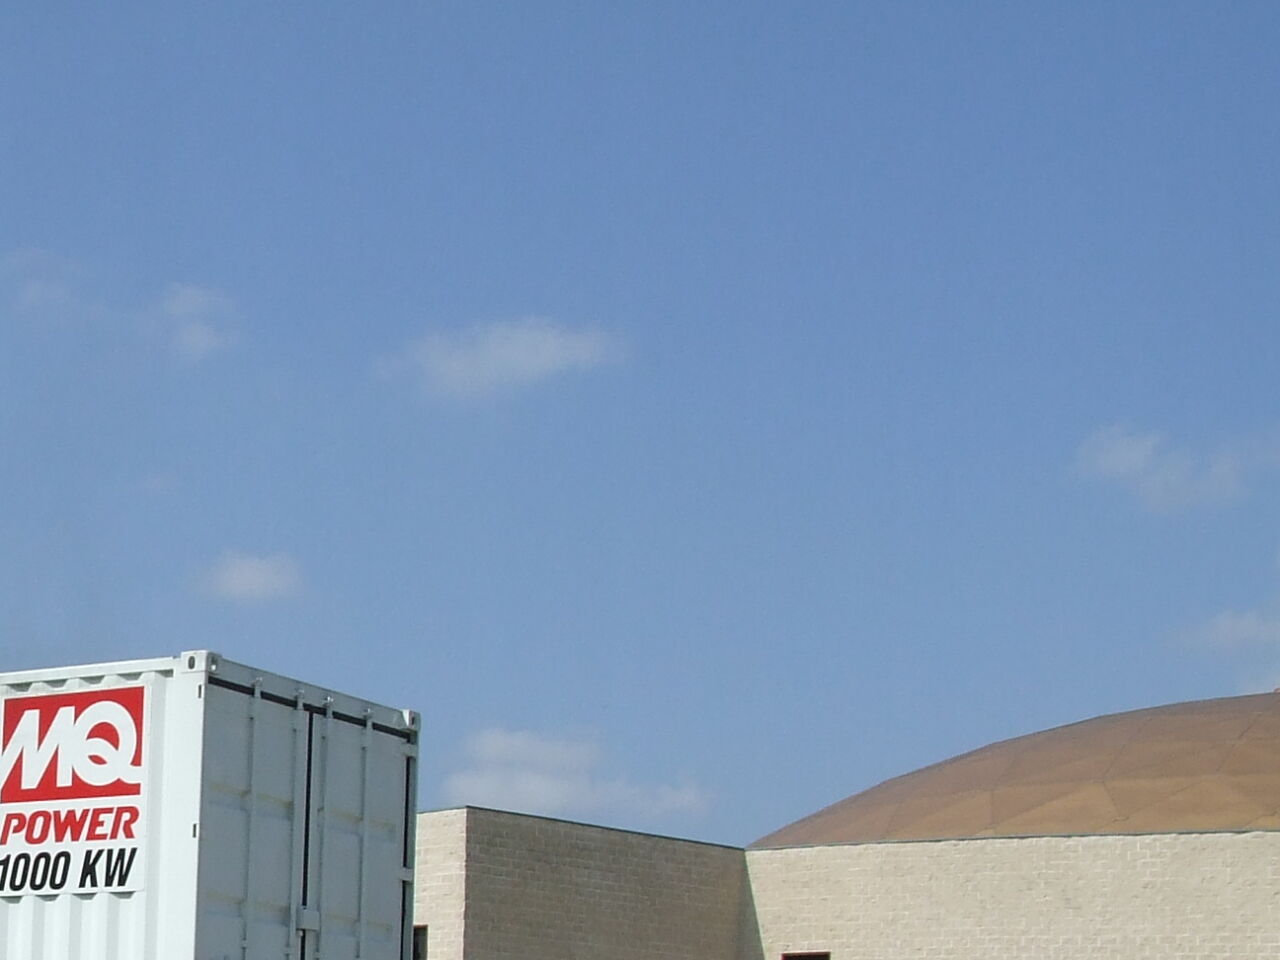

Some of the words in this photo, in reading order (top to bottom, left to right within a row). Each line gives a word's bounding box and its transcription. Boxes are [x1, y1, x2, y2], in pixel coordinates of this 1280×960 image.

[1, 700, 142, 789] MQ
[0, 806, 139, 846] POWER
[78, 848, 137, 888] KW
